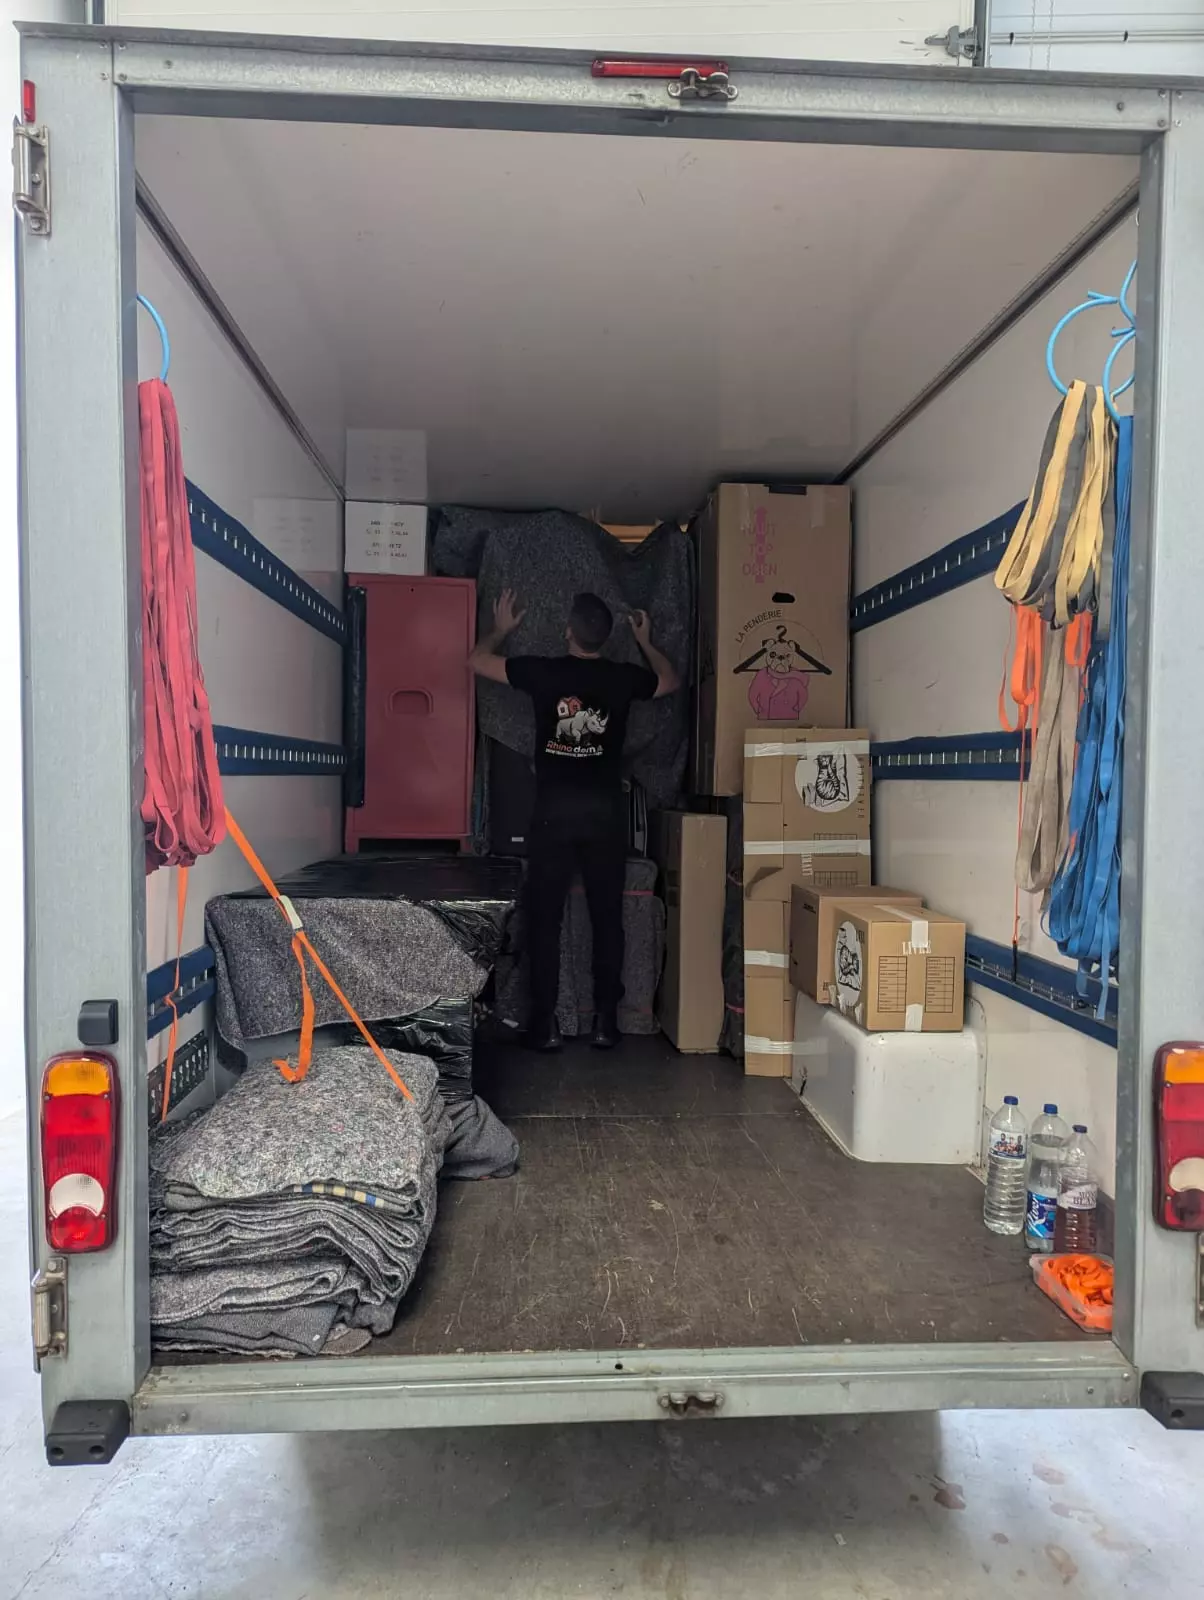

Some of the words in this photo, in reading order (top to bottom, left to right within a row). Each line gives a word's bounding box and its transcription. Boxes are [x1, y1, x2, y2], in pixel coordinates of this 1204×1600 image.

[748, 543, 774, 557] TOP
[735, 631, 745, 644] LA
[743, 609, 782, 632] PENDERIE
[546, 740, 573, 752] Rhino
